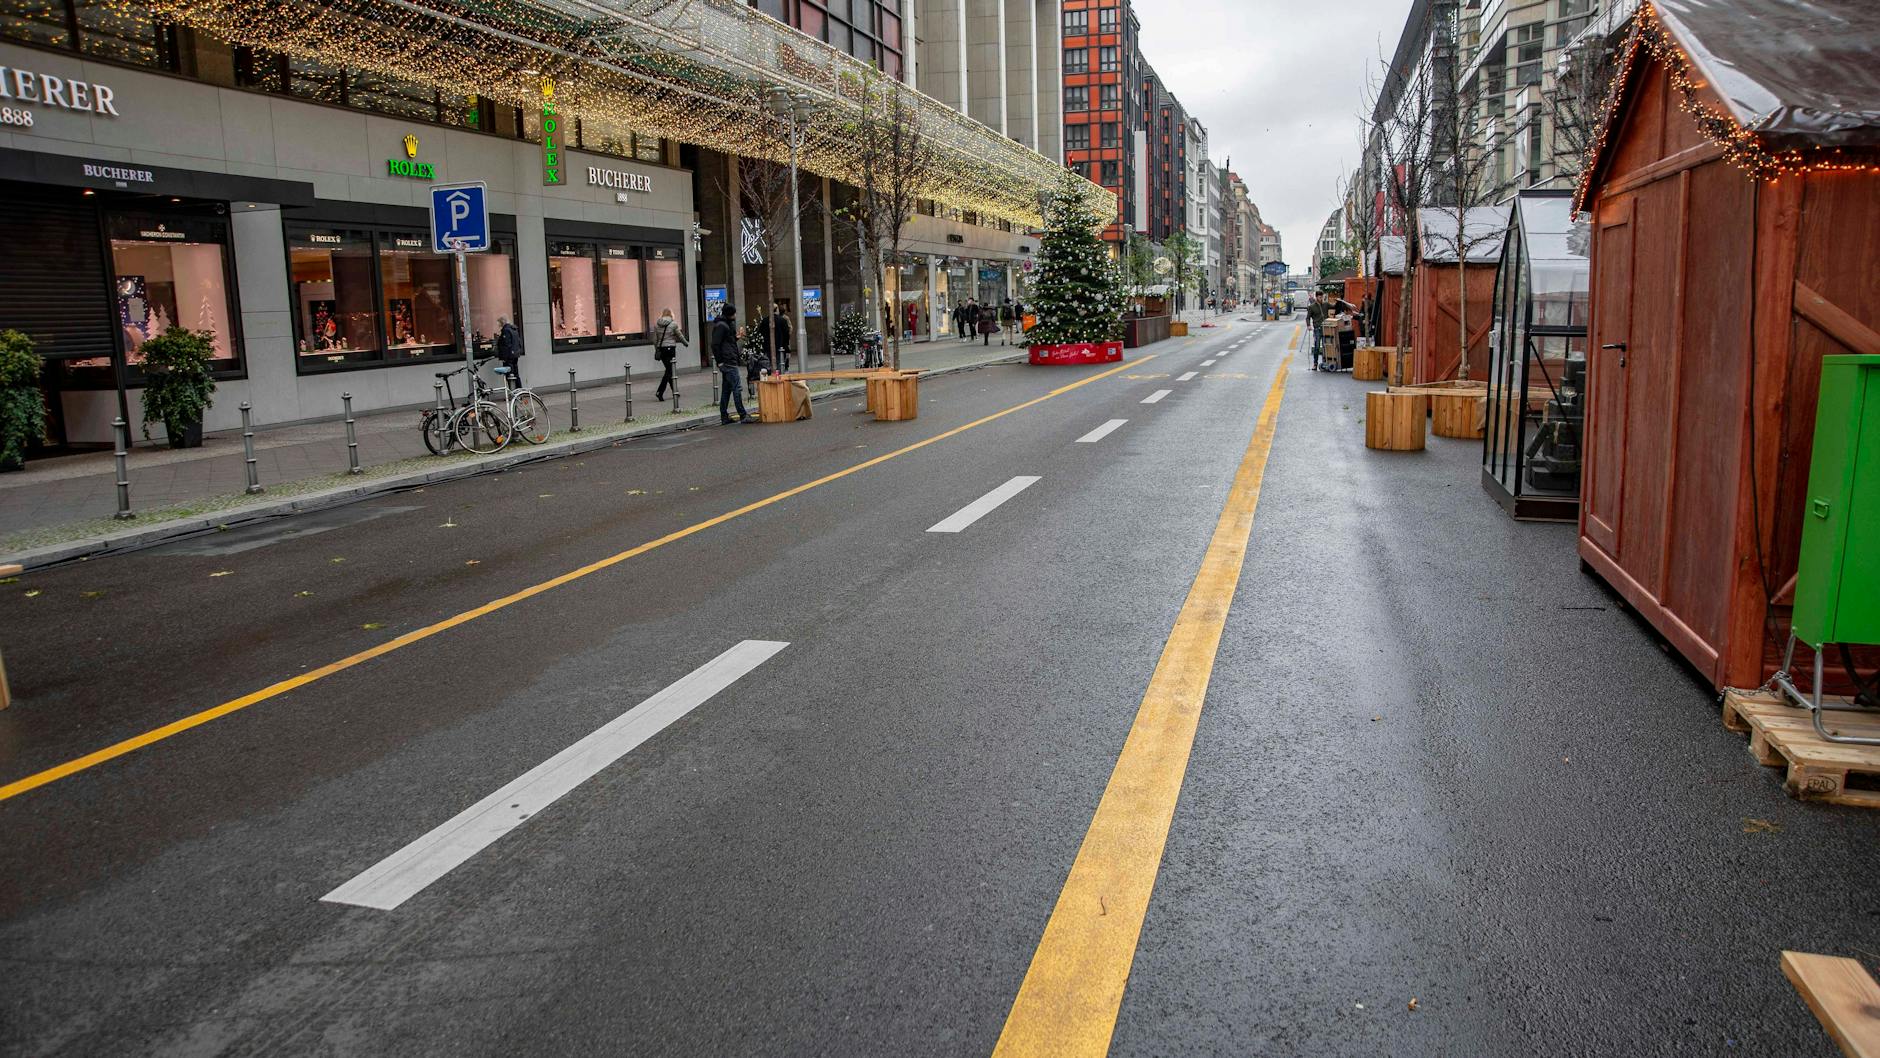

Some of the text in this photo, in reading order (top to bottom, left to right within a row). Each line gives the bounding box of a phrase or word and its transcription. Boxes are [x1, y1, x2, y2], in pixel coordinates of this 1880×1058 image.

[83, 164, 154, 182] BUCHERER
[389, 159, 436, 179] ROLEX
[588, 166, 652, 192] BUCHERER
[450, 200, 470, 231] P
[316, 235, 336, 243] ROLEX
[401, 239, 418, 247] ROLEX
